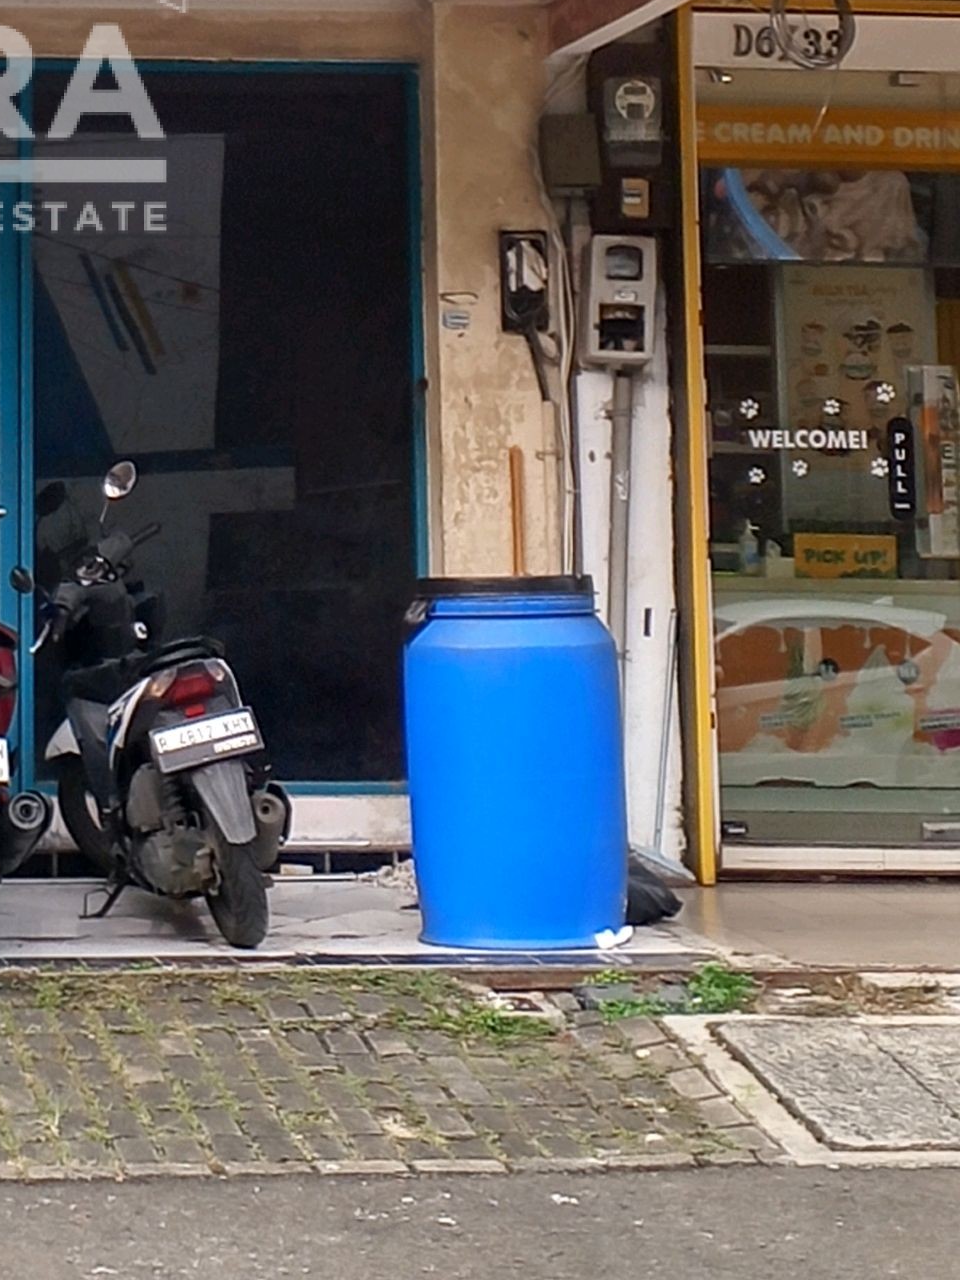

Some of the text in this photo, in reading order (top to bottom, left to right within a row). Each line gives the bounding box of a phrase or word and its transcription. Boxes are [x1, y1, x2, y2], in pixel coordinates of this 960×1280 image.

[714, 121, 813, 144] CREAM
[824, 123, 884, 146] AND
[748, 429, 868, 450] WELCOME!
[893, 432, 909, 494] PULL
[802, 547, 845, 564] PICK
